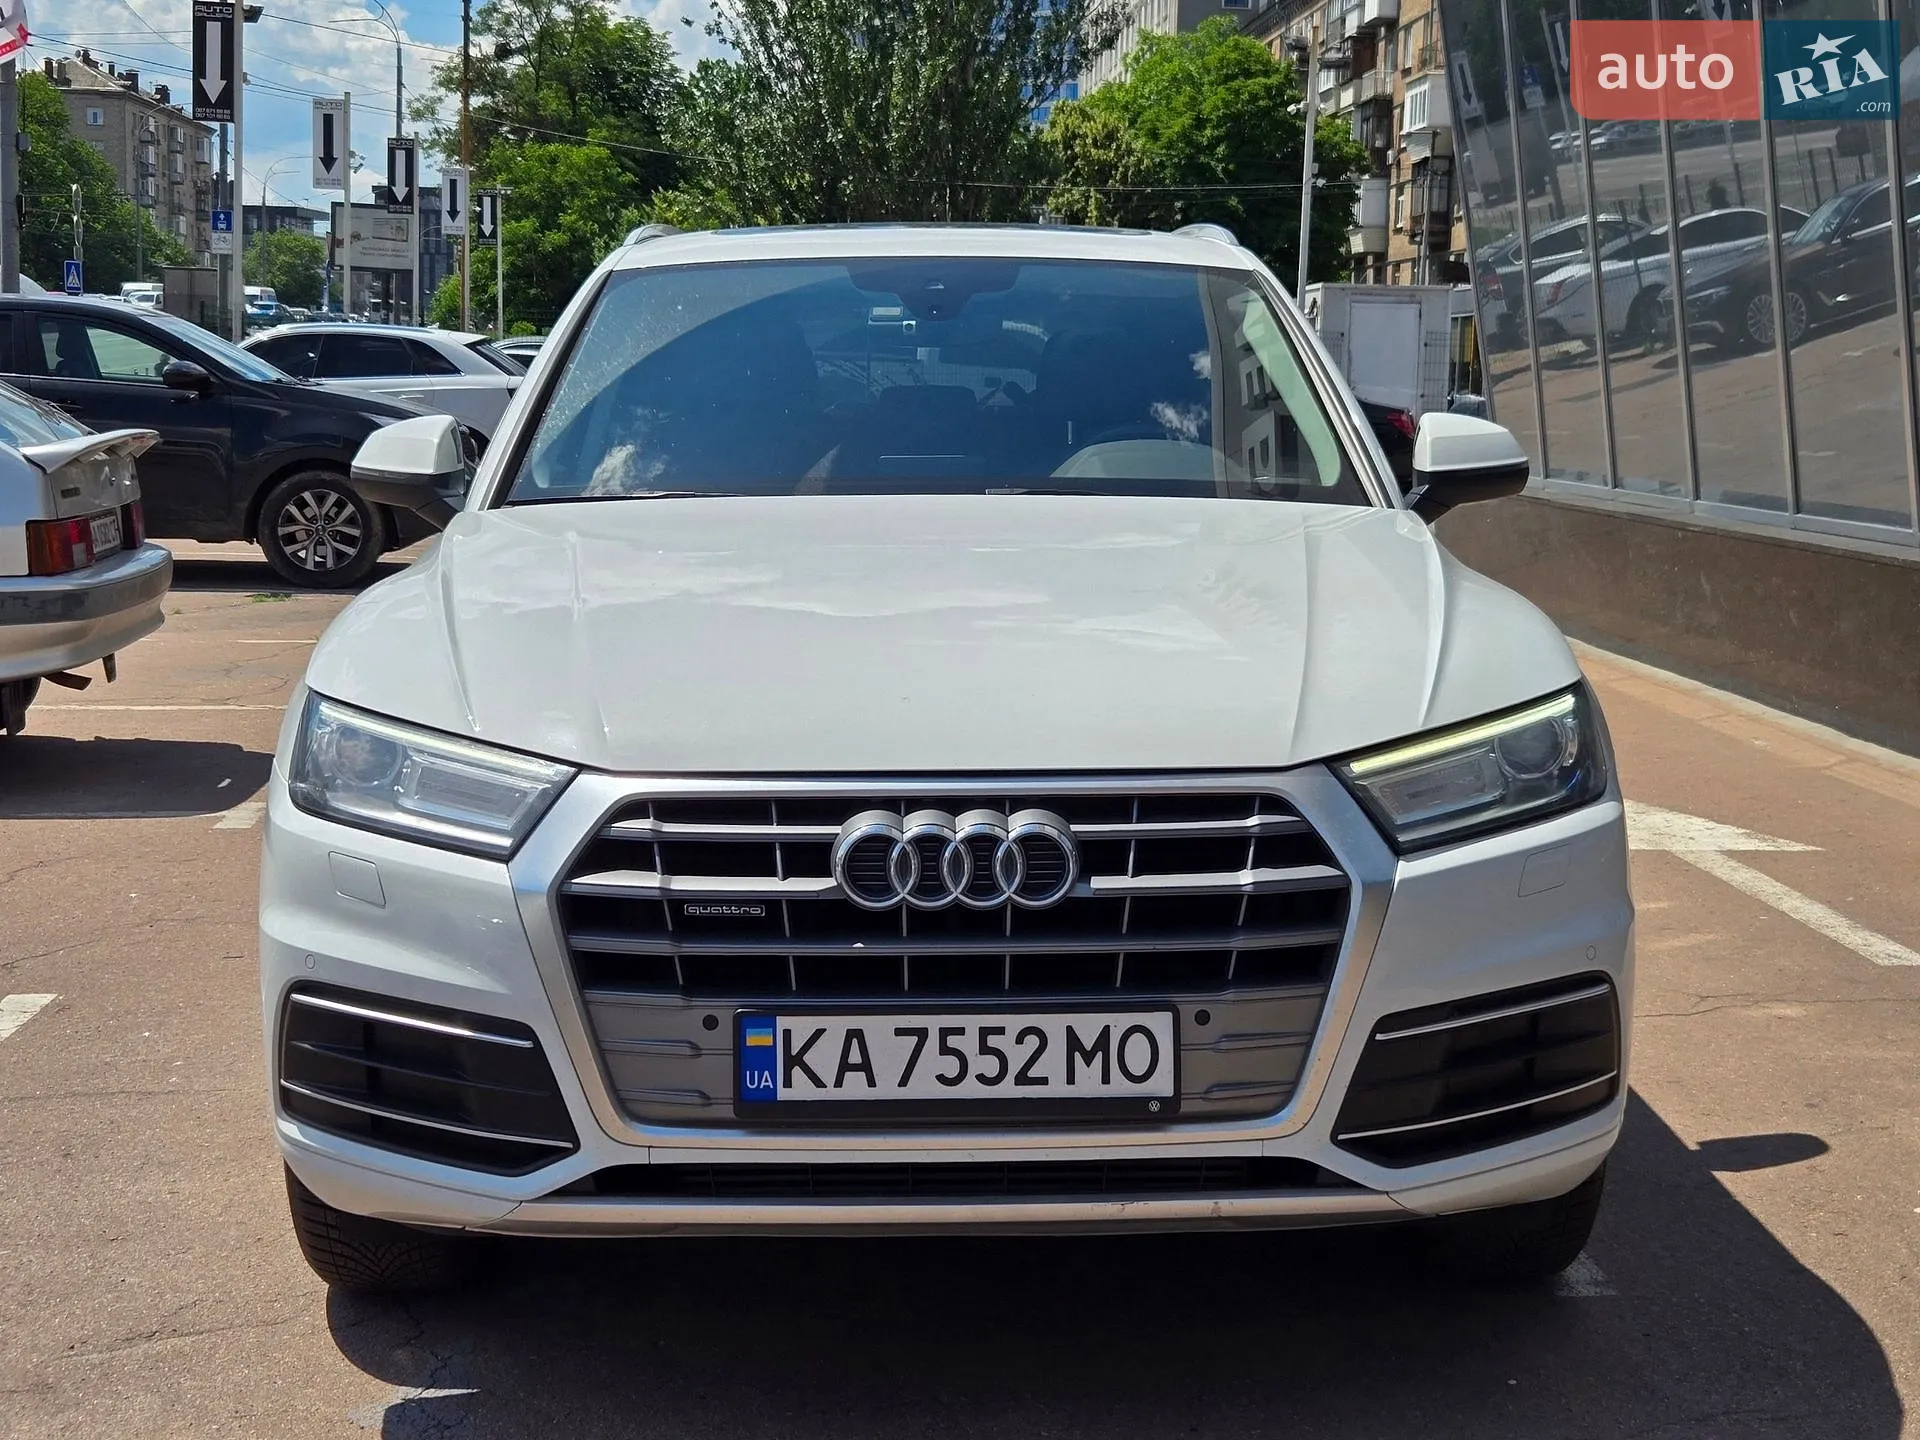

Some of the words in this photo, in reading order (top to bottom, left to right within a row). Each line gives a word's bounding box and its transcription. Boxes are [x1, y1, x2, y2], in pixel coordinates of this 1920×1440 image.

[195, 5, 232, 13] AUTO
[687, 906, 762, 915] quattro
[782, 1028, 877, 1089] KA
[894, 1025, 1049, 1087] 7552
[1065, 1024, 1160, 1085] MO
[746, 1071, 774, 1089] UA
